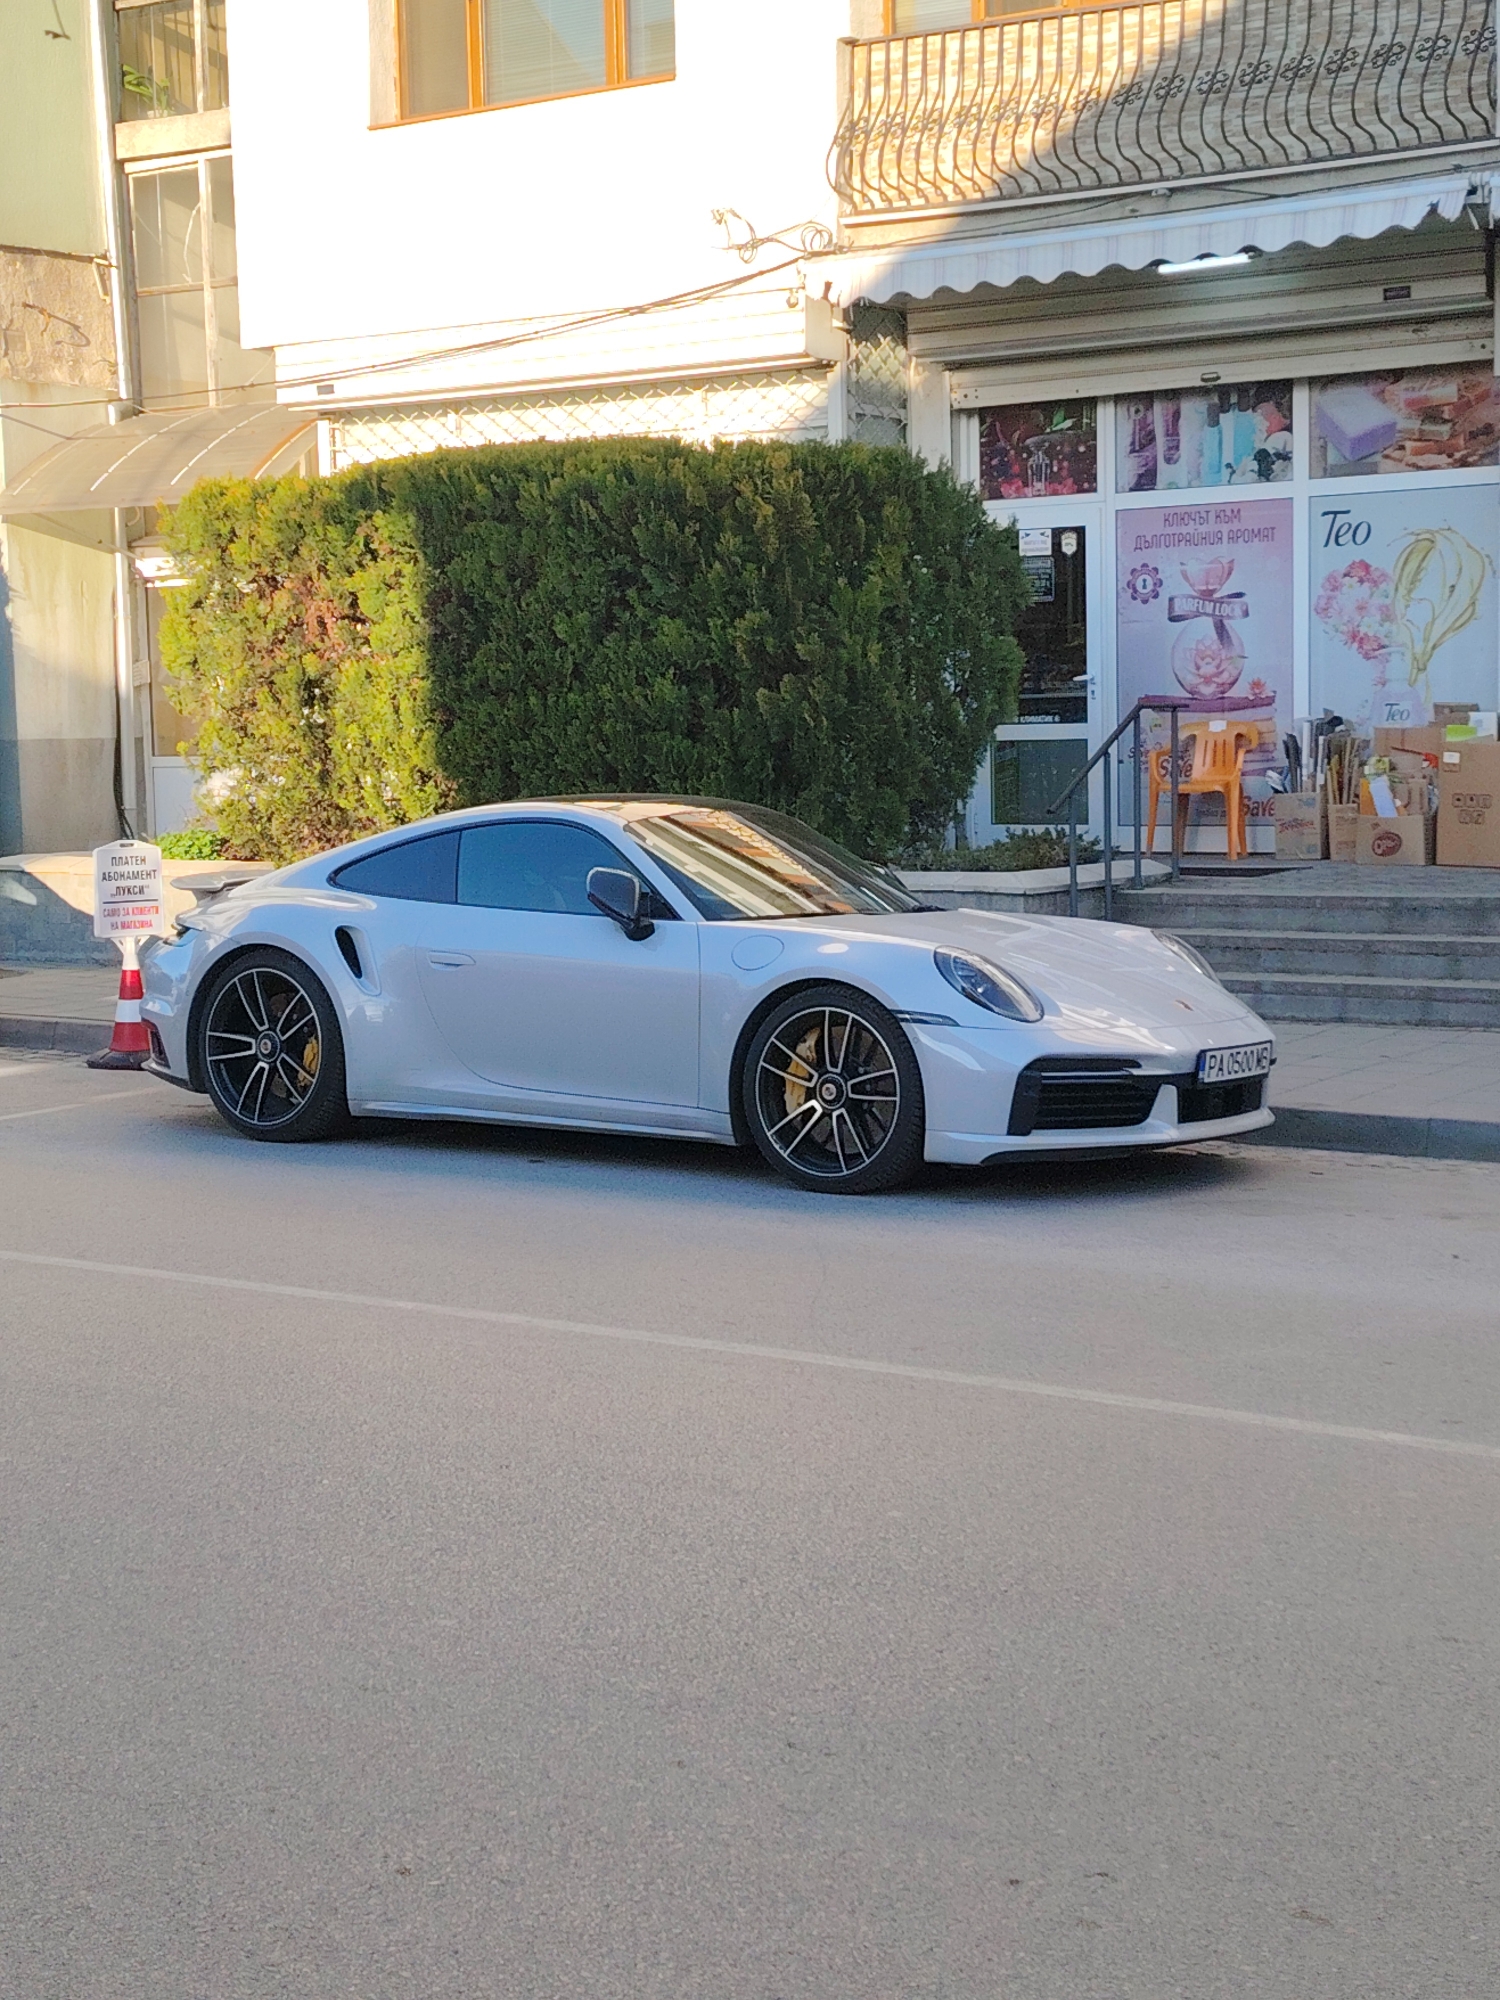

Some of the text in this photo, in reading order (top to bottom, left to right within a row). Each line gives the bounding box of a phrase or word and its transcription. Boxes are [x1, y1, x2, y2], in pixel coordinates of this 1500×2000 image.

[1163, 507, 1242, 528] КЛЮЧЪТ КЪМ
[1320, 509, 1372, 548] Teo
[1133, 526, 1277, 552] ДЪЛГОТРАЙНИЯ АРОМАТ
[1174, 597, 1214, 614] PARFUM
[1384, 702, 1411, 722] Teo
[1160, 758, 1193, 778] Sve
[111, 855, 147, 867] ПЛАТЕН
[101, 869, 158, 882] АБОНАМЕНТ
[103, 907, 121, 918] САМО
[122, 906, 130, 917] ЗА
[110, 920, 119, 930] НА
[1207, 1053, 1225, 1079] PA
